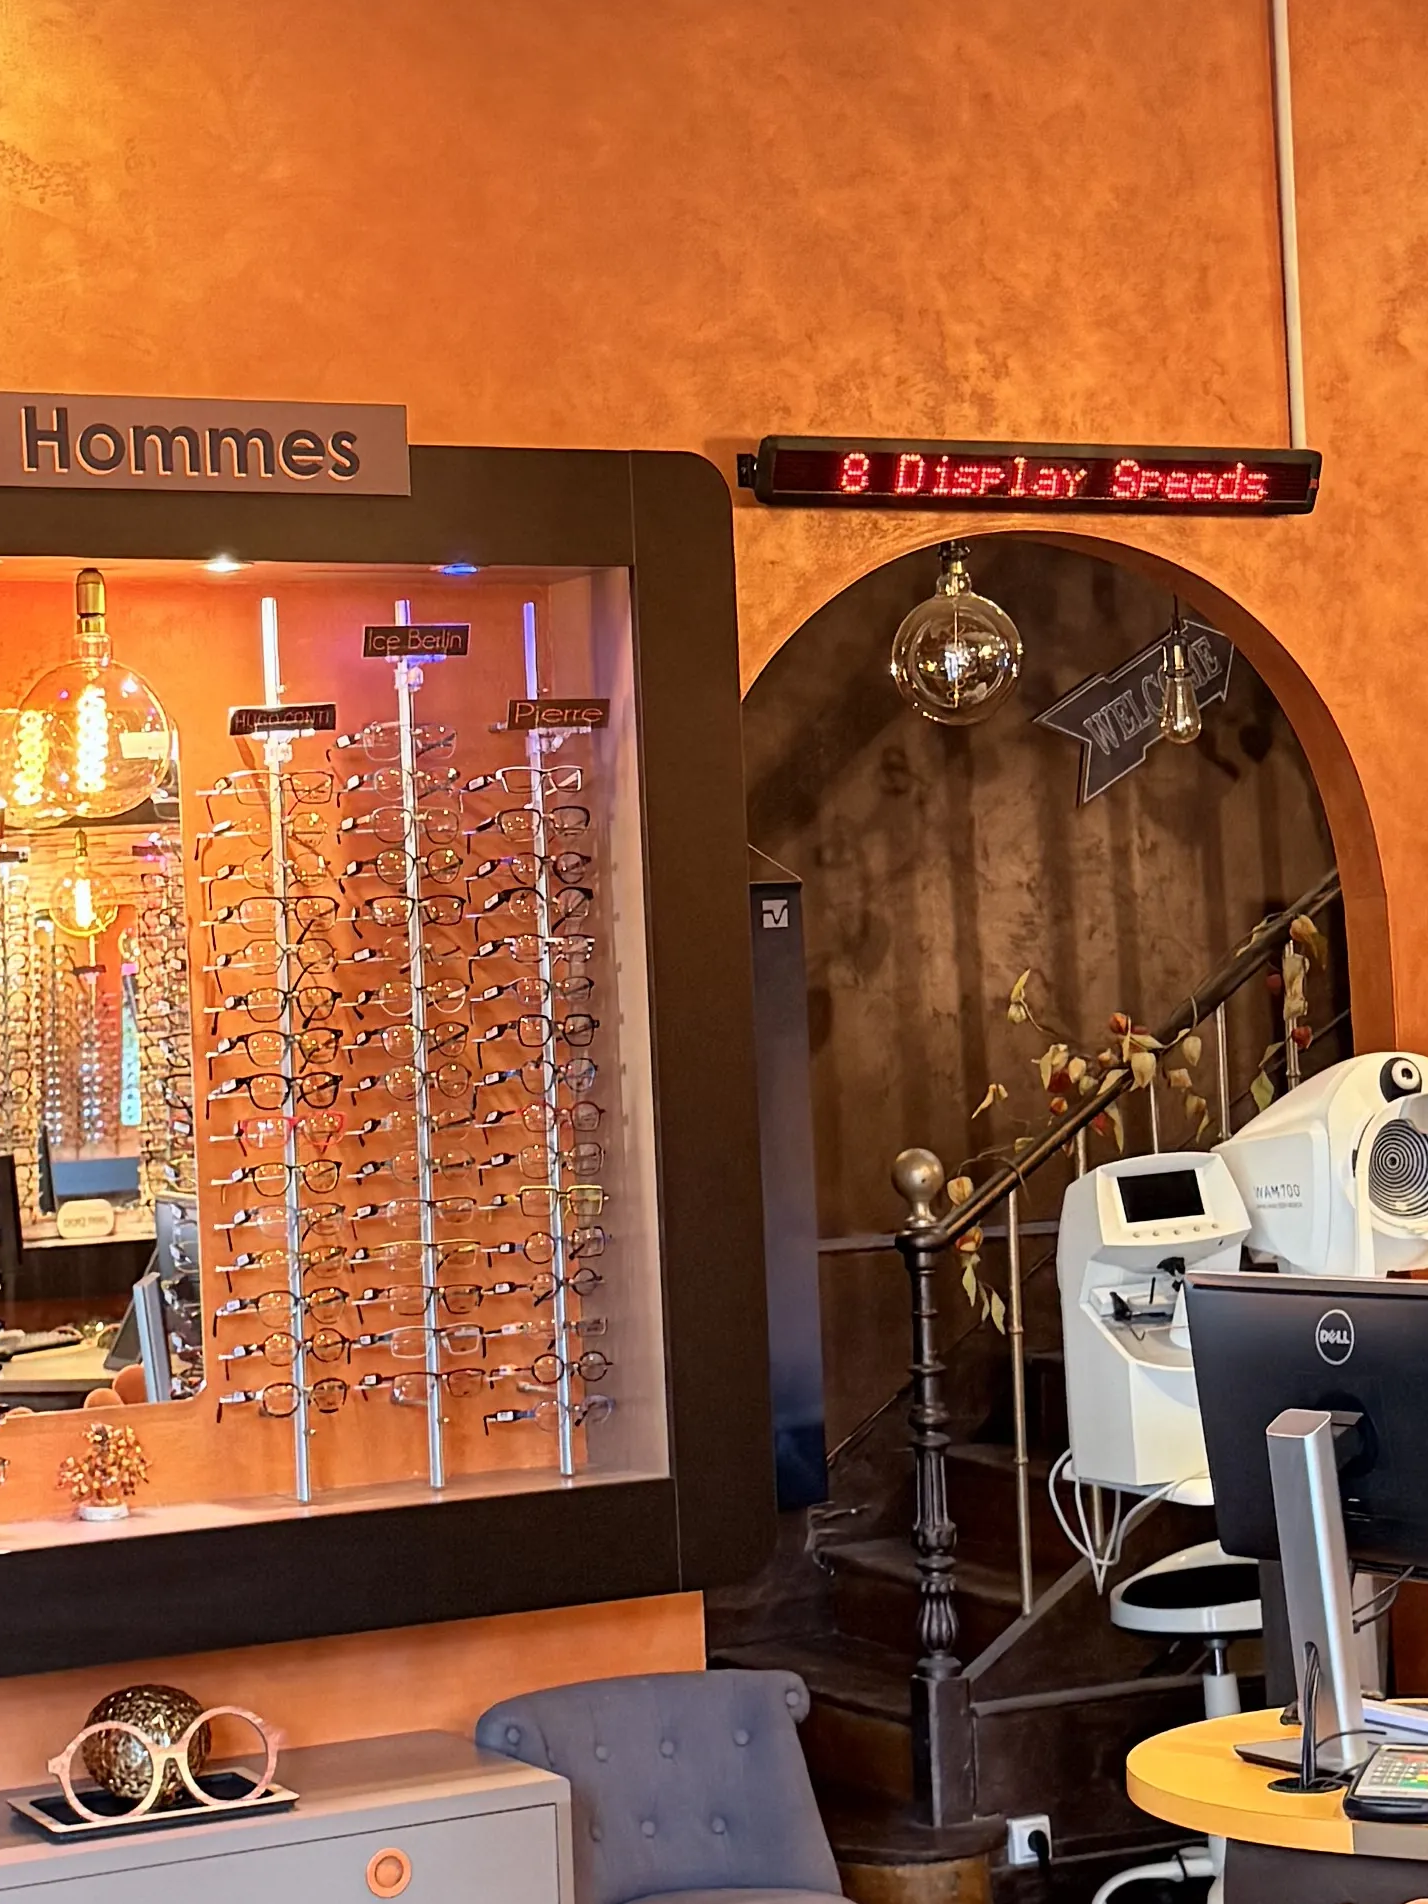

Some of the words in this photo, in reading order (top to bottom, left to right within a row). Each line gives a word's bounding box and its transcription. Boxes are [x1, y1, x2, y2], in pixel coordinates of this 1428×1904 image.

[22, 405, 361, 482] Hommes
[841, 453, 870, 492] 8
[896, 454, 1087, 496] Display
[1112, 459, 1268, 500] Speeds
[369, 629, 400, 650] Ice
[408, 628, 462, 649] Berlin
[1083, 636, 1223, 755] WELCE
[515, 702, 603, 724] Pierre
[1320, 1329, 1350, 1344] DELL
